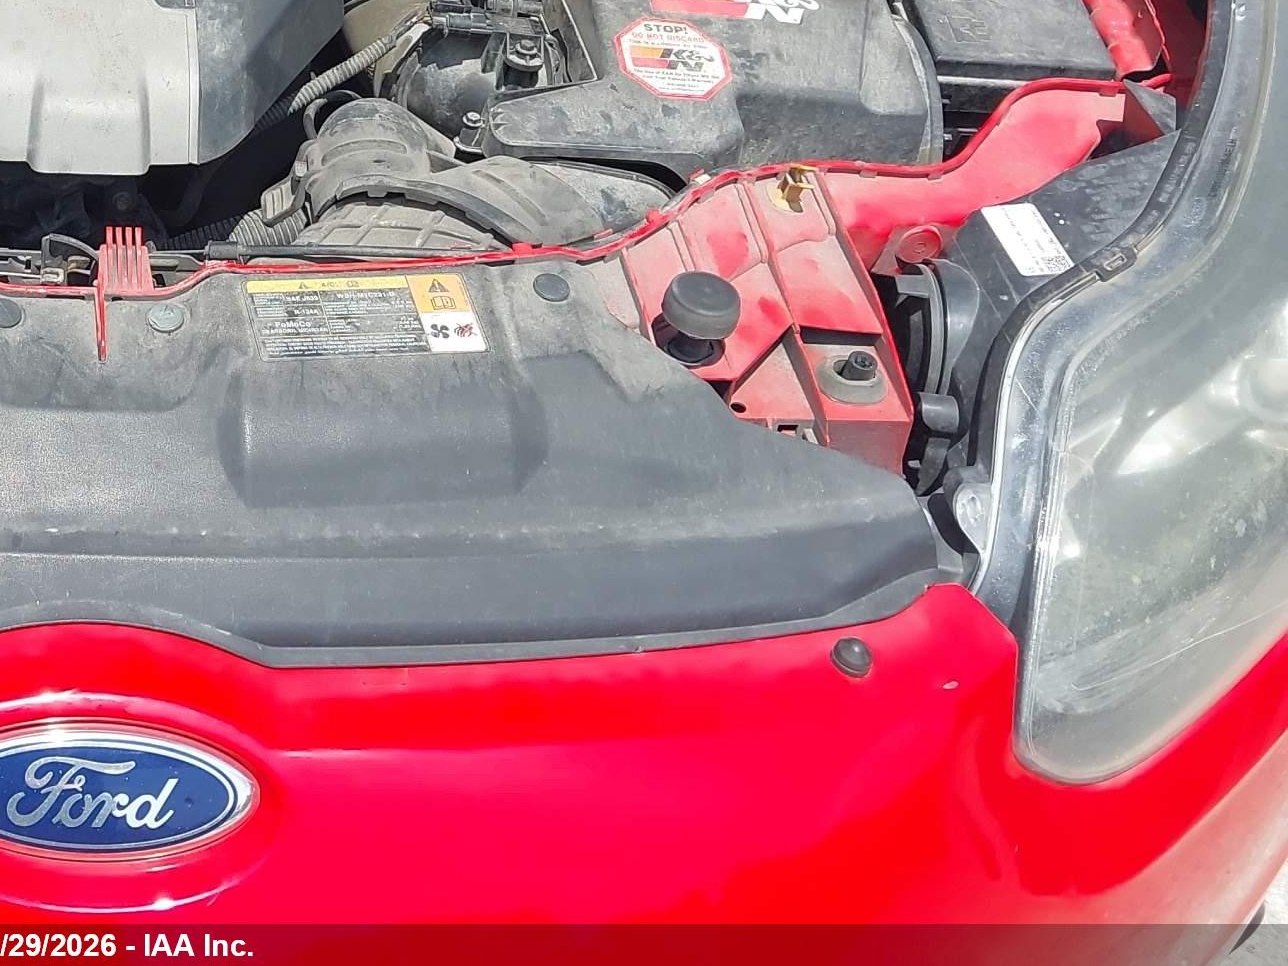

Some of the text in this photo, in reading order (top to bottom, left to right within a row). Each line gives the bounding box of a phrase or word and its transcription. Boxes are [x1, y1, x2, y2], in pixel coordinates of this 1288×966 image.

[632, 32, 706, 43] DO NOT DISCARD
[643, 23, 688, 35] STOP!
[659, 48, 715, 72] K&N
[6, 756, 179, 829] Ford
